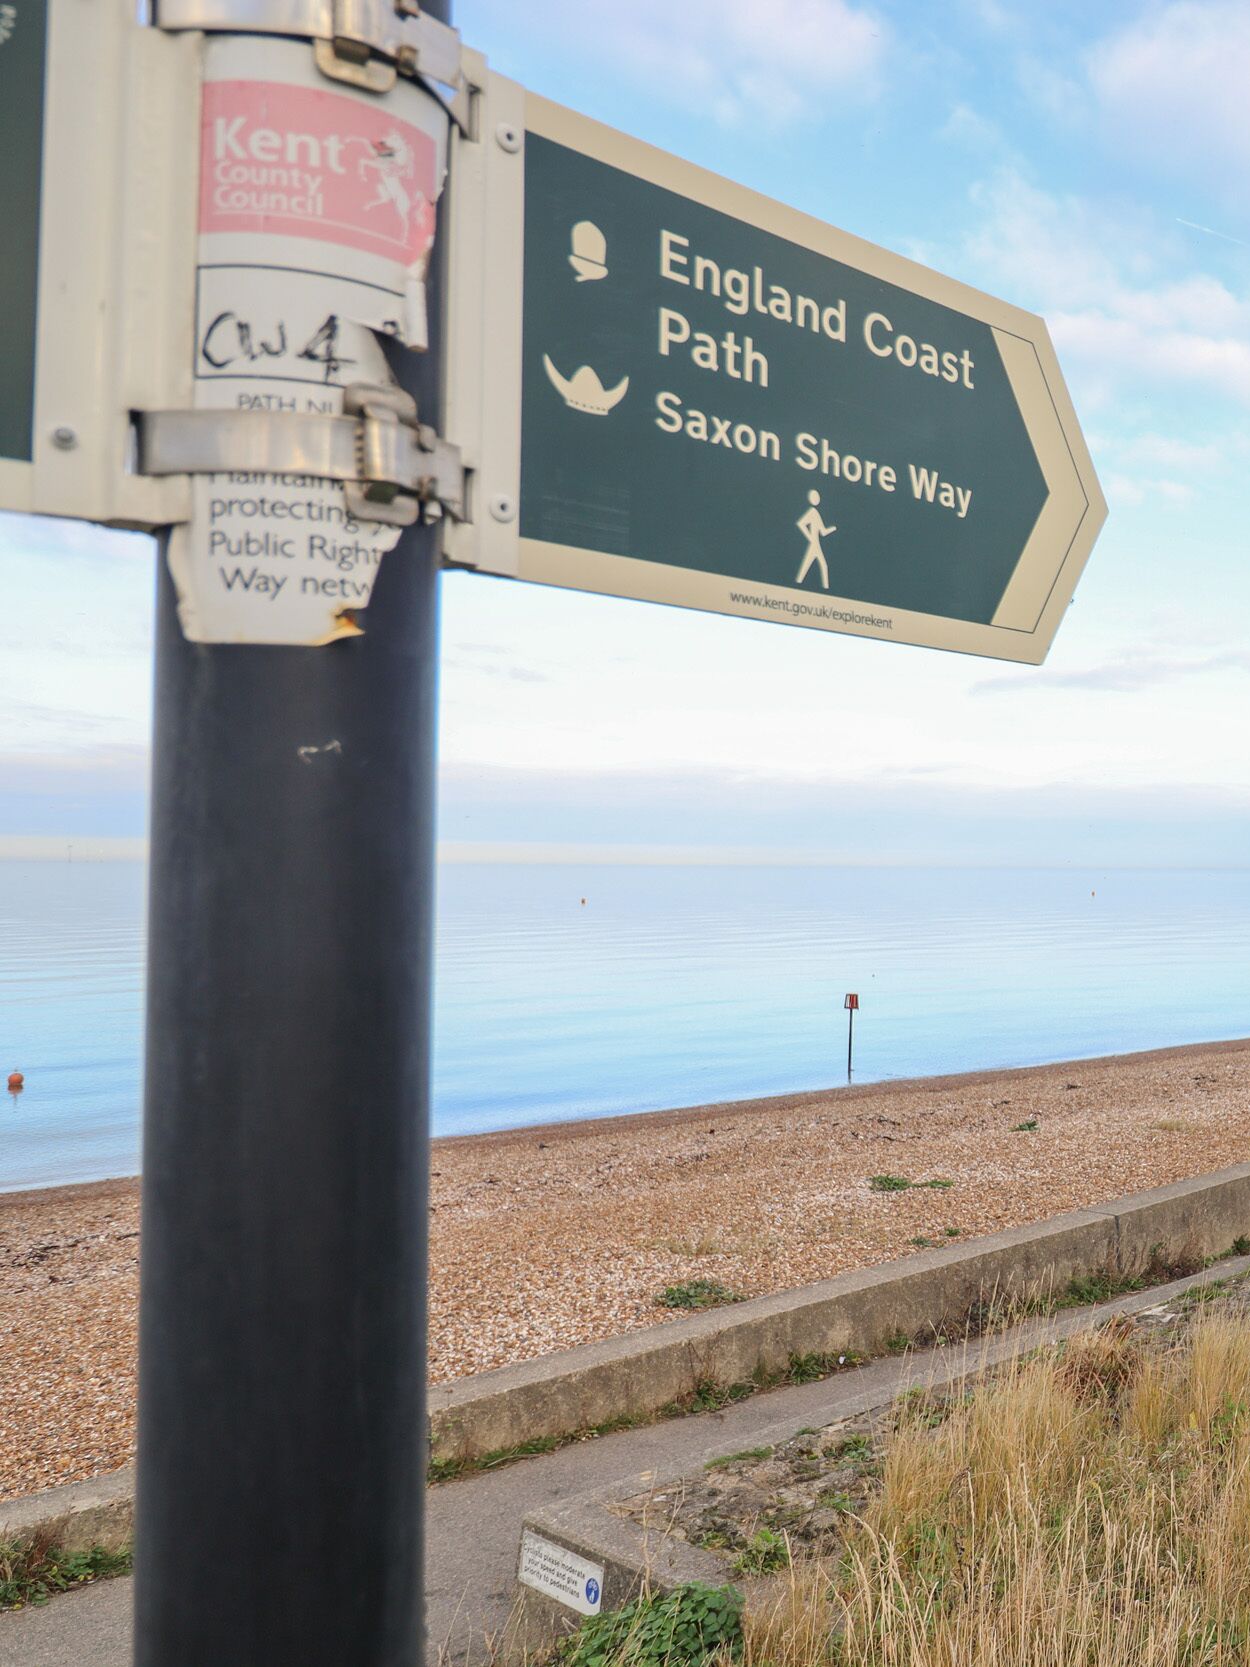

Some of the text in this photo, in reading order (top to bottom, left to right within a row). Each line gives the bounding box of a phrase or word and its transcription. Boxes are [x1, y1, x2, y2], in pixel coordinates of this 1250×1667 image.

[213, 116, 346, 175] Kent
[214, 160, 323, 195] County
[213, 184, 324, 217] Council
[658, 228, 975, 390] England Coast
[658, 306, 769, 388] Path
[237, 392, 297, 412] PATH
[654, 390, 973, 519] Saxon Shore Way
[208, 528, 296, 560] Public
[219, 565, 288, 601] Way
[729, 591, 893, 630] www.kent.gov.uk/explorekent
[528, 1559, 578, 1588] your speed and give
[543, 1554, 560, 1568] please
[561, 1563, 585, 1580] moderate
[550, 1578, 580, 1599] pedestrians
